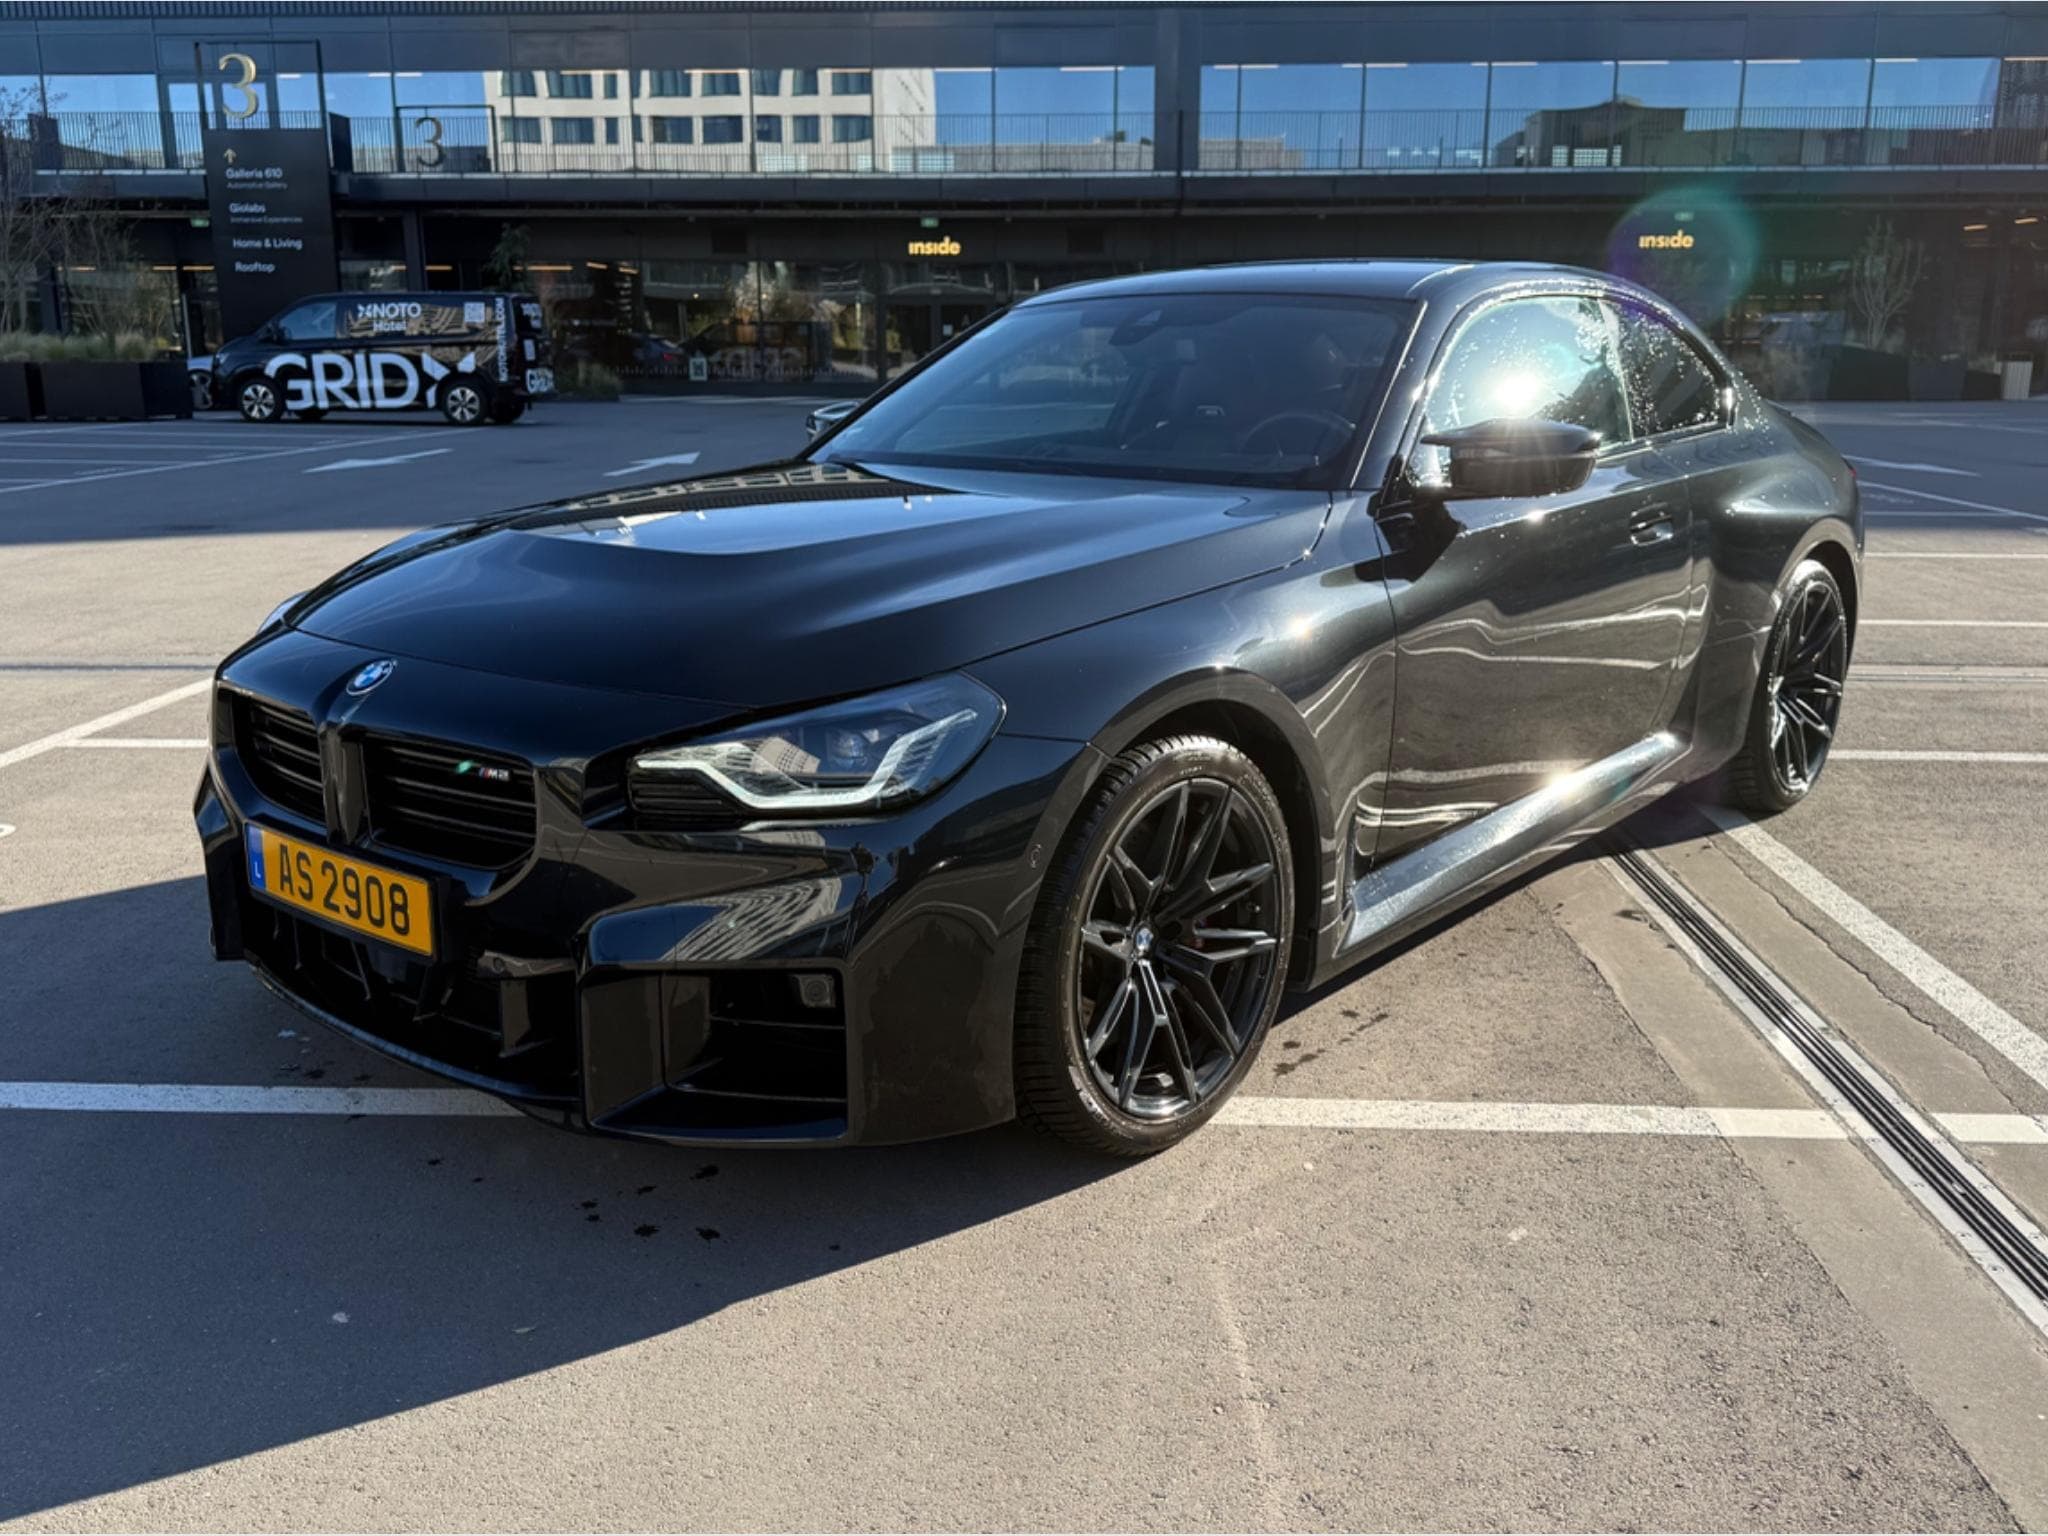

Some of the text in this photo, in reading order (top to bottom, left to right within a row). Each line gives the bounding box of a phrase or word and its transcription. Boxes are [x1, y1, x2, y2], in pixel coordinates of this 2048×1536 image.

[218, 53, 259, 118] 3
[415, 117, 446, 166] 3
[225, 167, 283, 179] Galleria 610
[233, 238, 303, 251] Home & Living
[235, 261, 276, 274] Rooftop
[373, 320, 407, 332] Hotel
[253, 843, 411, 937] L AS 2908
